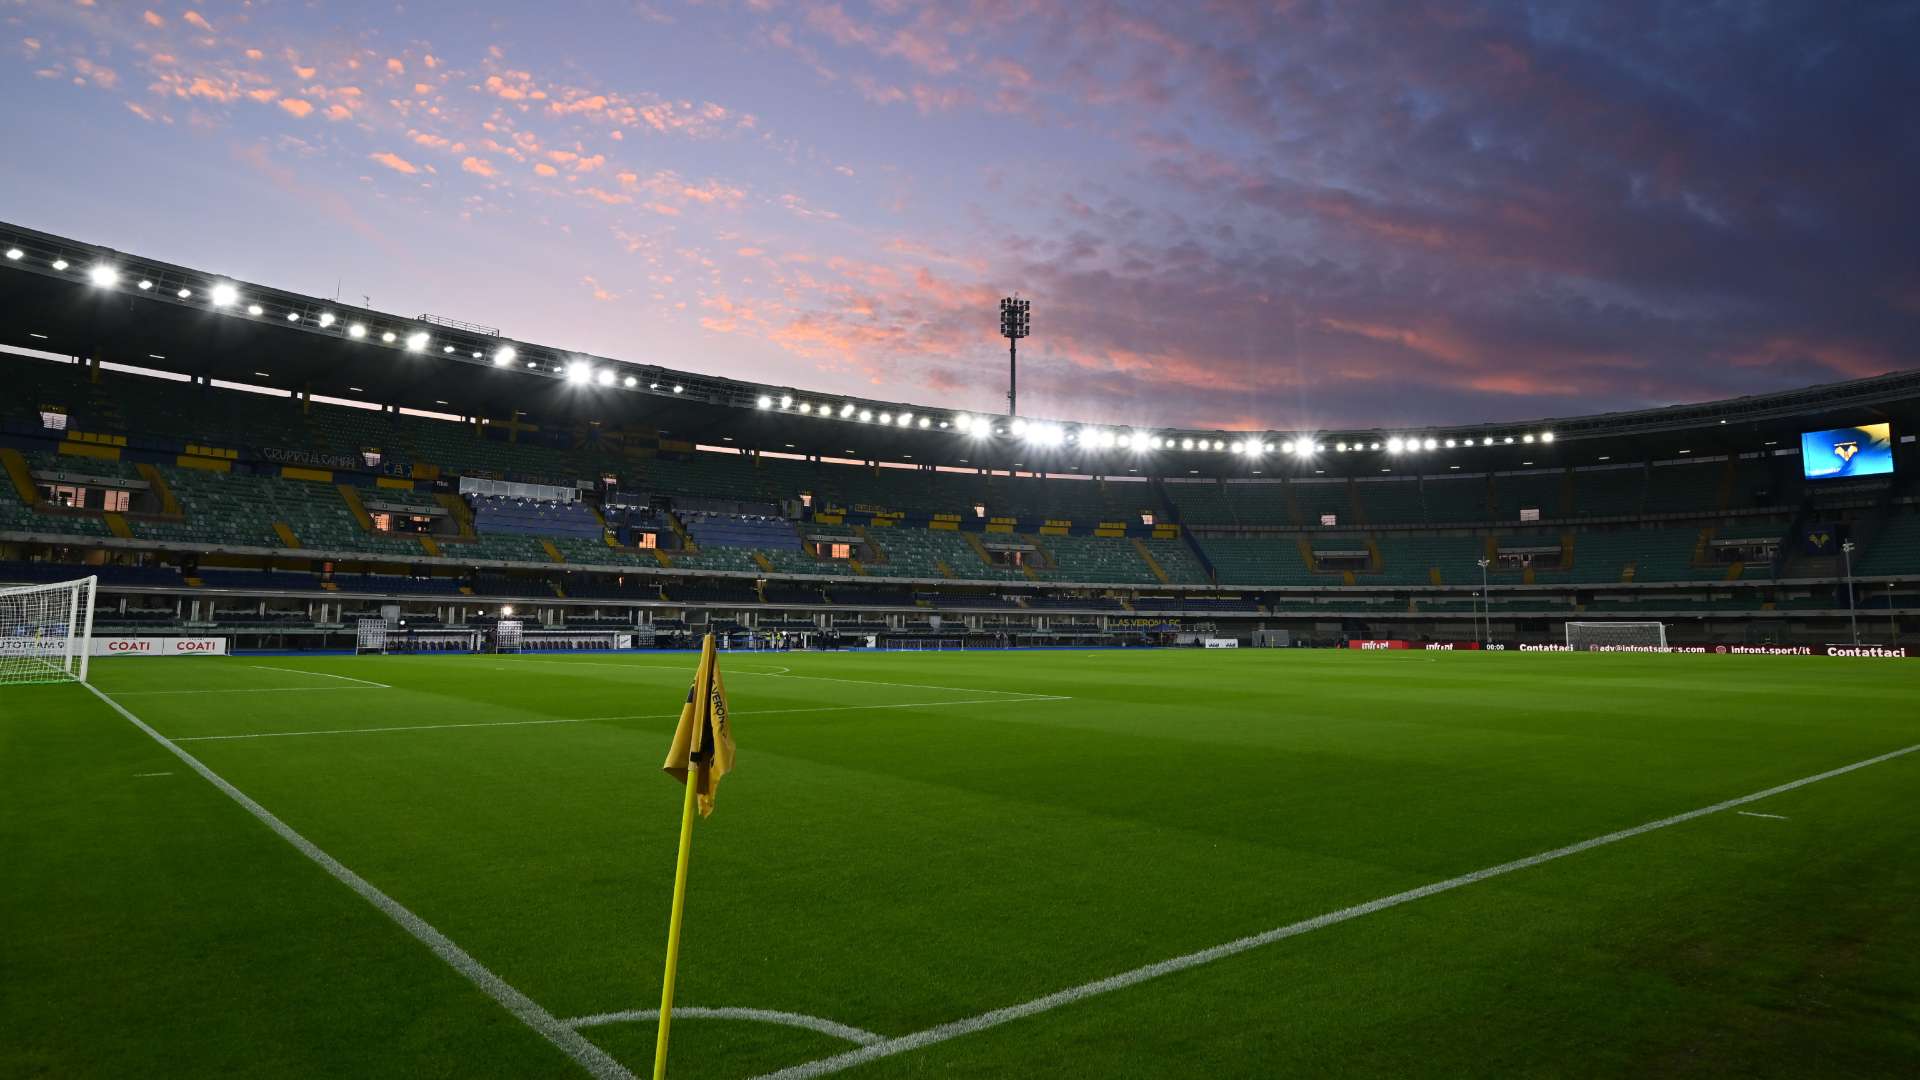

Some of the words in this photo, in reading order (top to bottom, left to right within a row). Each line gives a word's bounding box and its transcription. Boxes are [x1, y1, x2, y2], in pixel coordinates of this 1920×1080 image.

[109, 641, 150, 650] COATI
[176, 641, 215, 650] COATI
[1520, 644, 1574, 652] Contattaci
[1731, 646, 1811, 655] infront.sport/it
[1827, 647, 1905, 658] Contattaci
